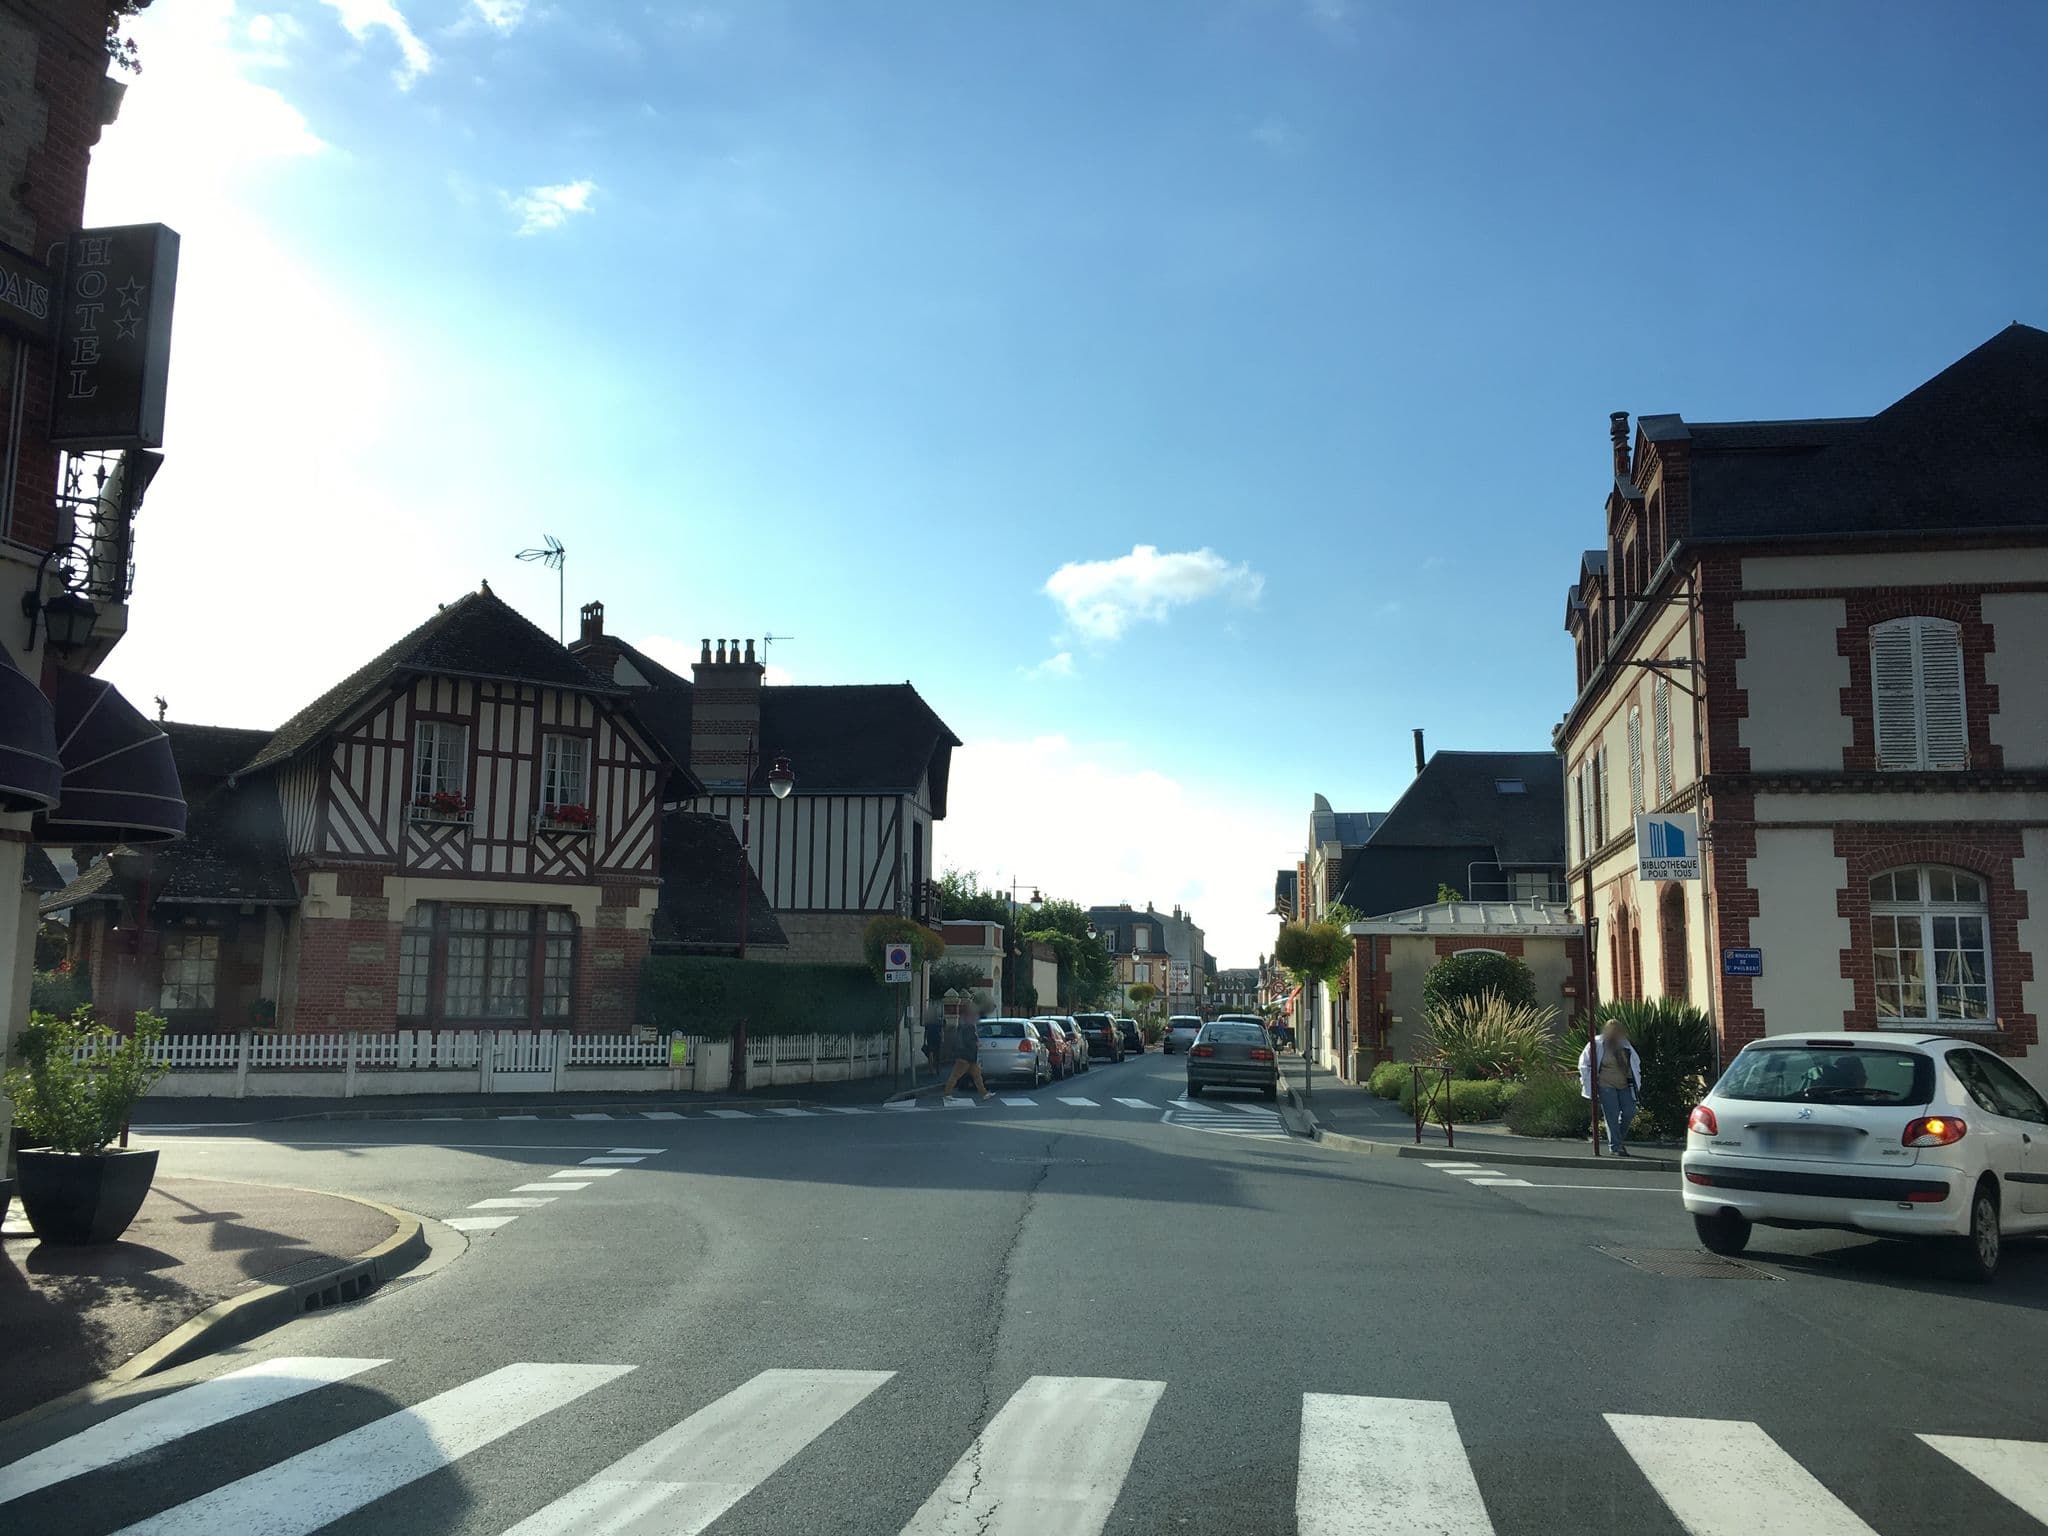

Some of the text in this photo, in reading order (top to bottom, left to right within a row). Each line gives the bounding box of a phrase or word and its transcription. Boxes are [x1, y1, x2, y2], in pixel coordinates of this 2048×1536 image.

[67, 238, 112, 399] HOTEL
[1642, 860, 1697, 870] BIBLIOTHEQUE
[1648, 869, 1693, 878] POUR TOUS
